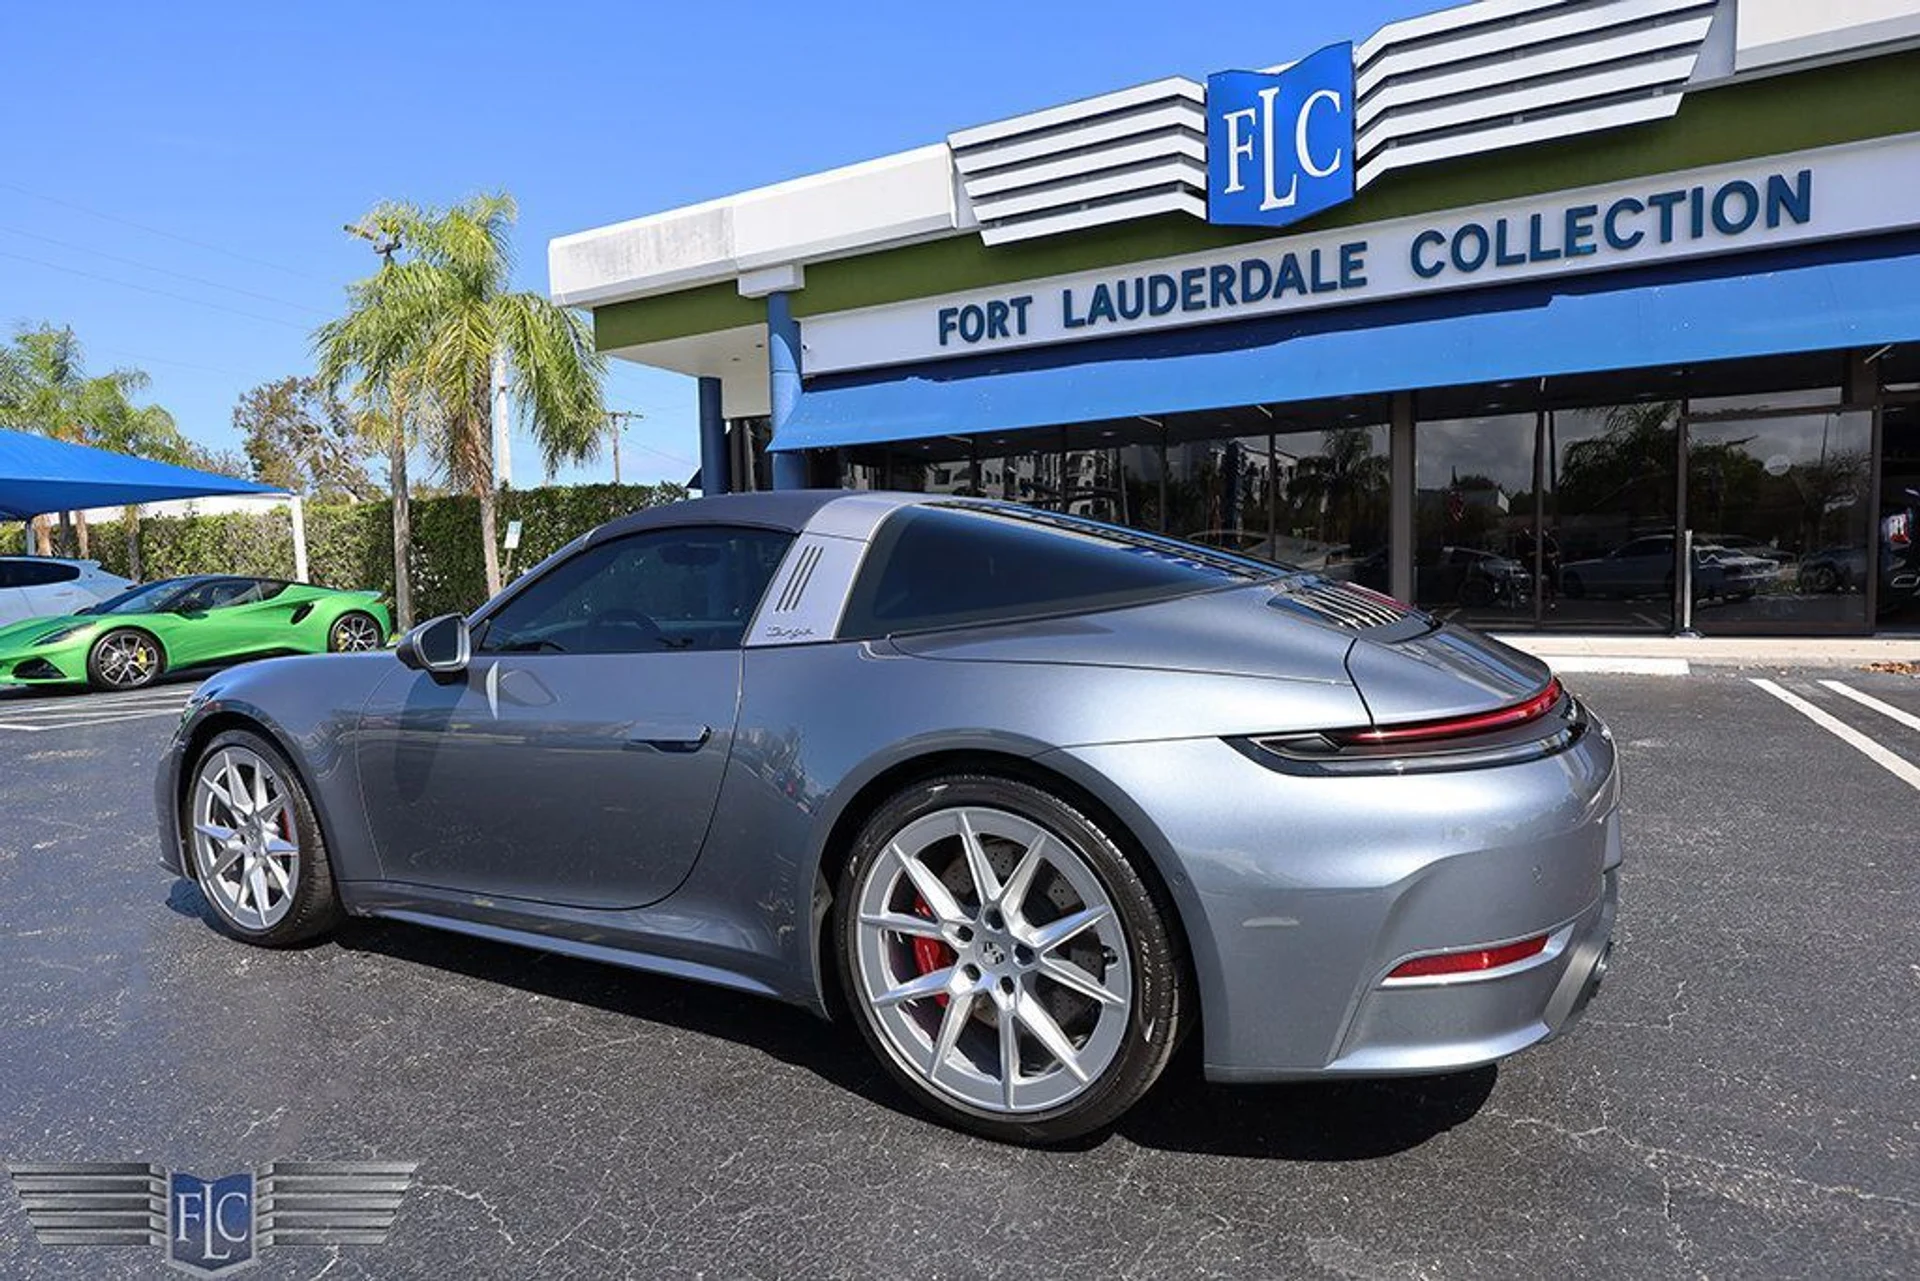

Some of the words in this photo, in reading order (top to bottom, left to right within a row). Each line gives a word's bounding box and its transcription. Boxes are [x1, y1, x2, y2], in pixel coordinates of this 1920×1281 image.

[1223, 86, 1341, 211] FLC
[938, 296, 1033, 345] FORT
[1063, 241, 1368, 329] LAUDERDALE
[1410, 169, 1813, 279] COLLECTION
